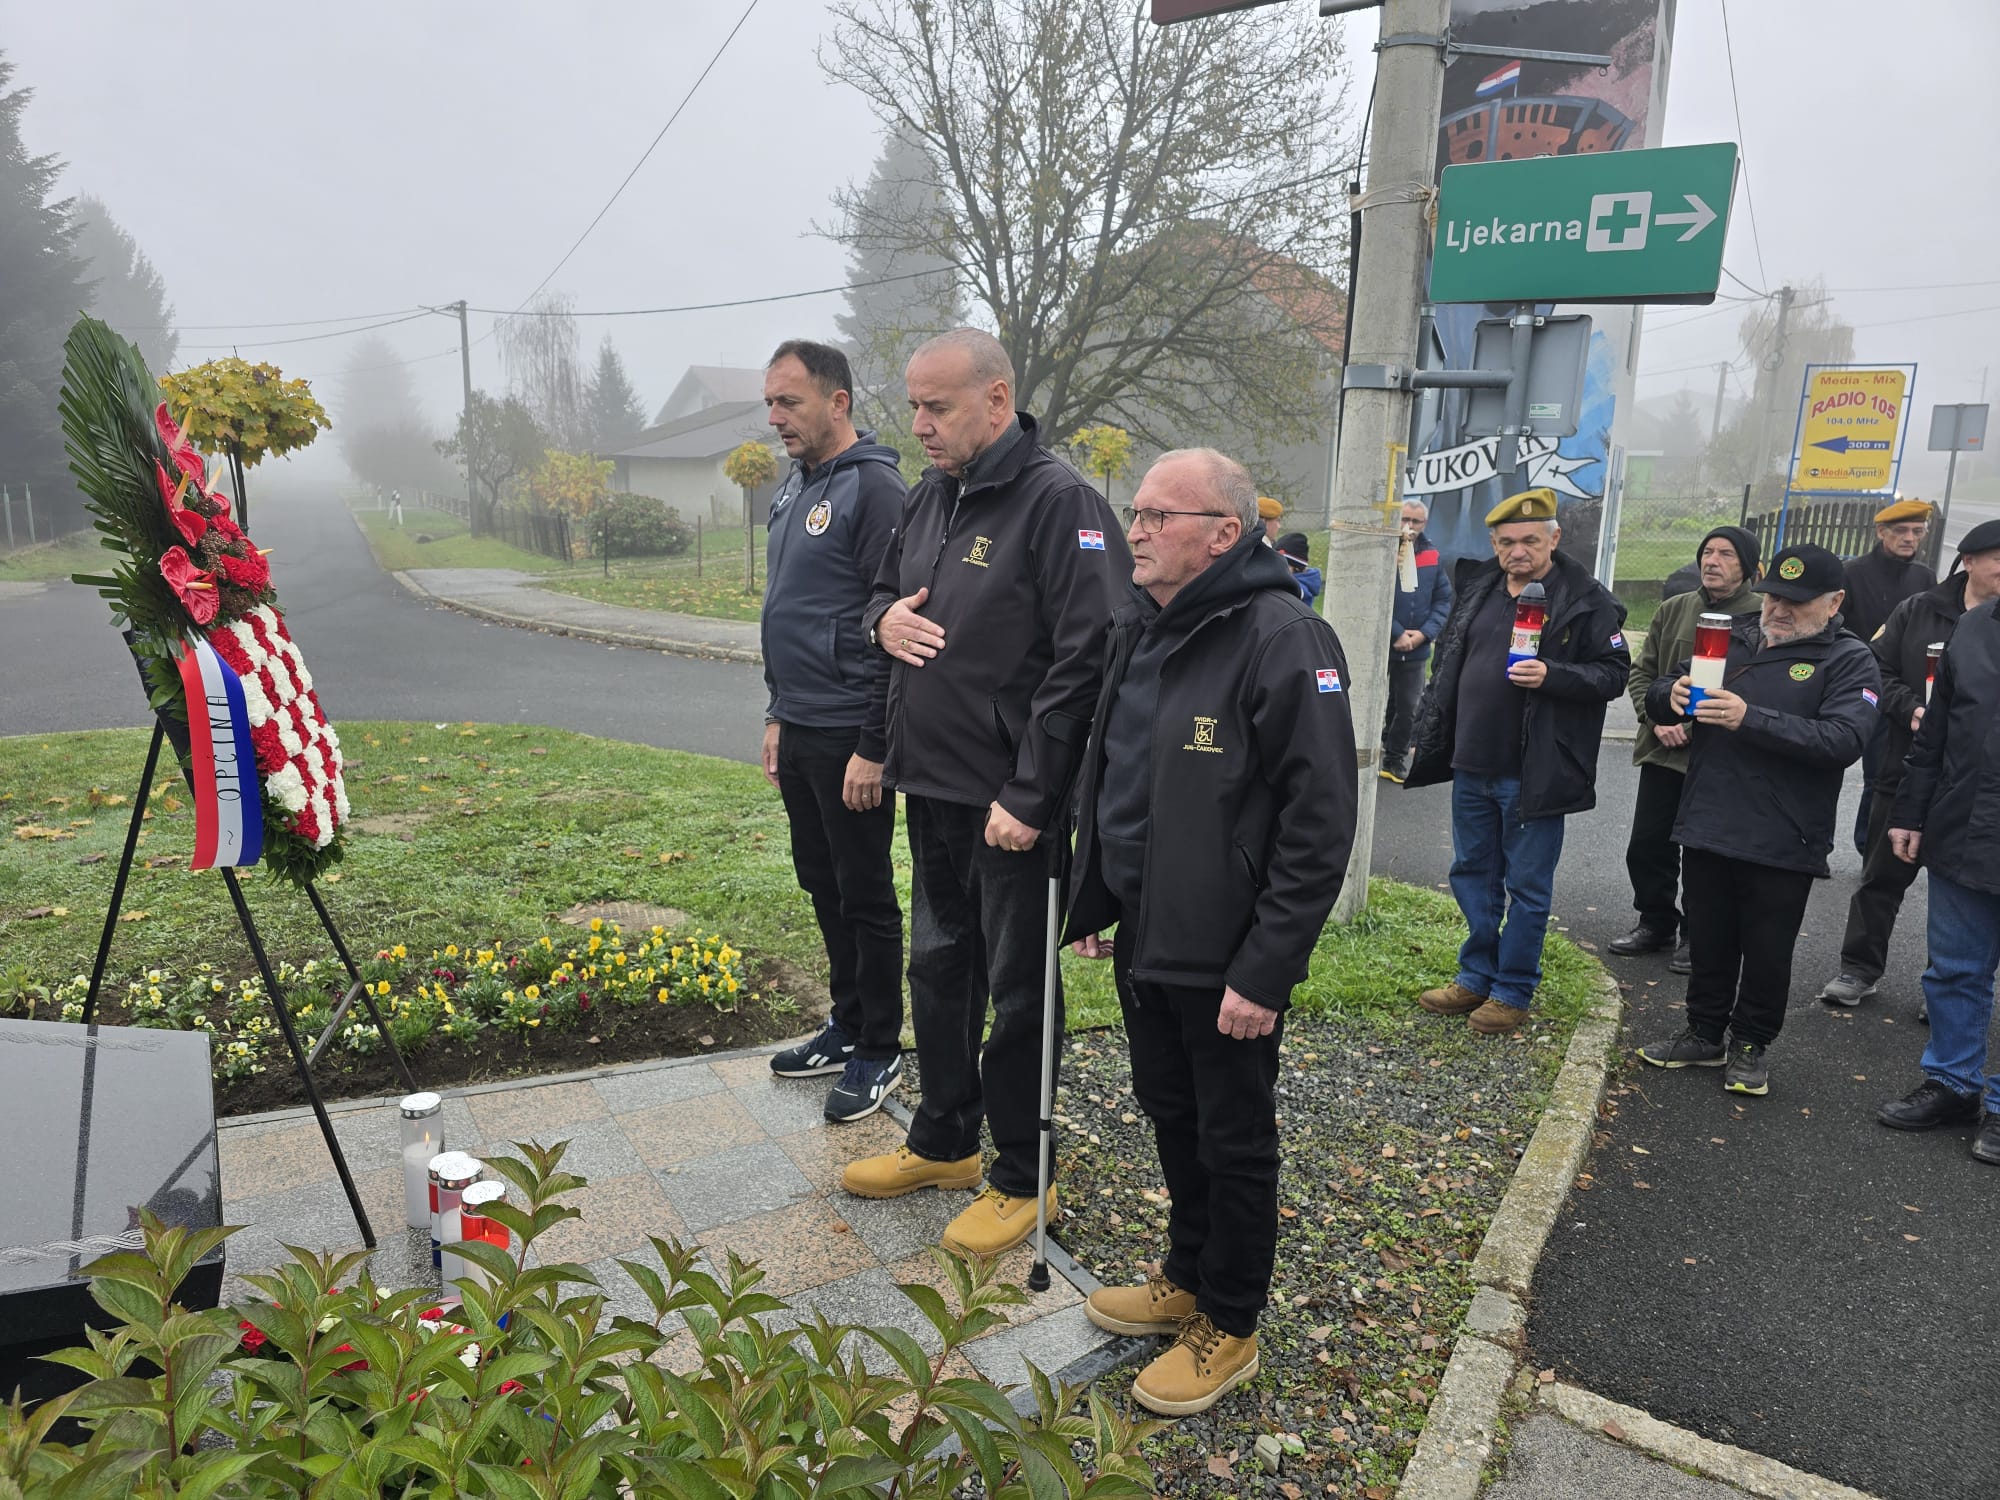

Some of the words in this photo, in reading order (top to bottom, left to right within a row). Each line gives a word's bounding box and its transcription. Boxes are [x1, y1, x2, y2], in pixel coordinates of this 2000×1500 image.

[1446, 216, 1582, 253] Ljekarna
[1820, 376, 1860, 385] Media
[1873, 375, 1897, 385] Mix
[1811, 392, 1866, 418] RADIO
[1871, 395, 1896, 420] 105
[1848, 441, 1871, 449] 300
